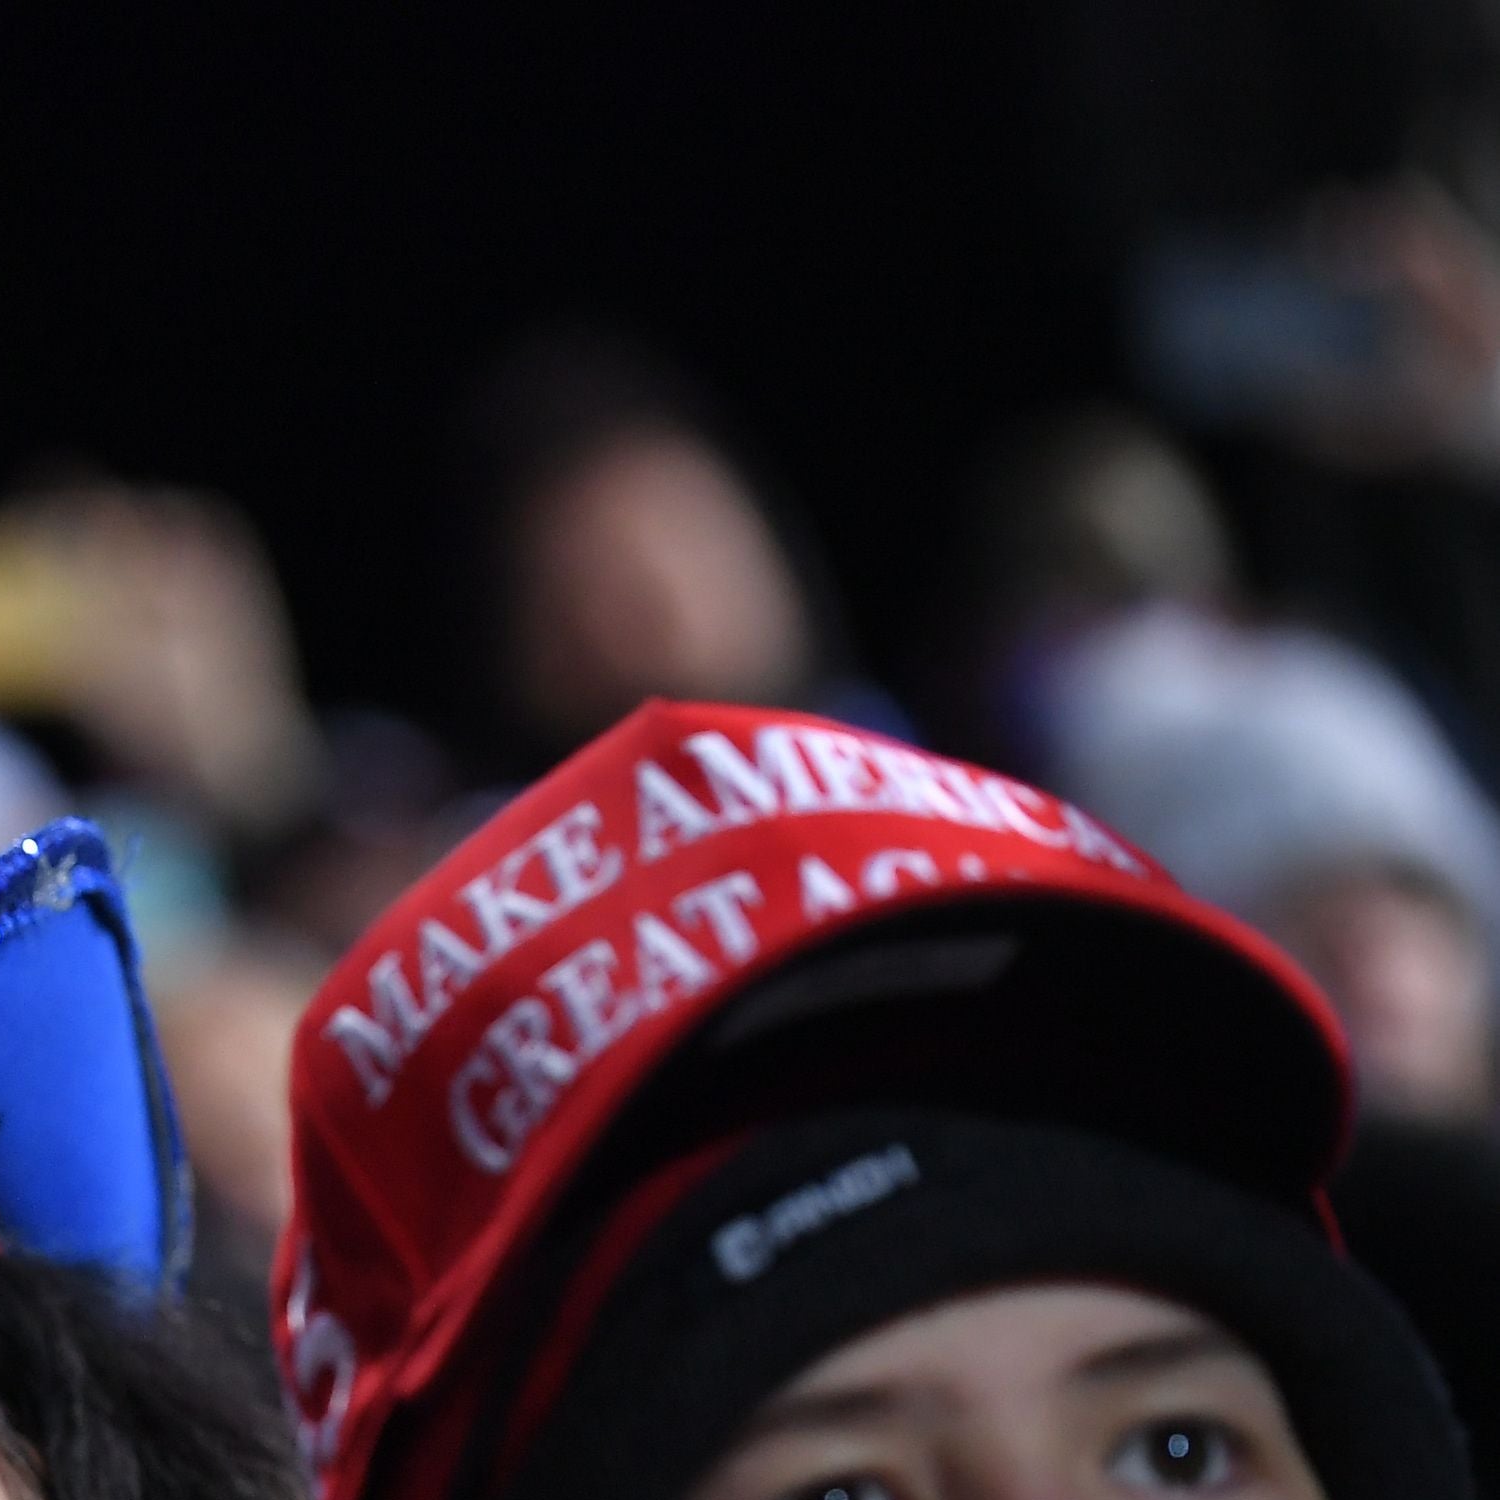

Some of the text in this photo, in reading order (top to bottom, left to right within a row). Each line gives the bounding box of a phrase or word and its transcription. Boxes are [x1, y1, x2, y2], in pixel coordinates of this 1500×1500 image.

[321, 724, 1153, 1110] MAKE AMERICA
[447, 870, 765, 1178] GREAT
